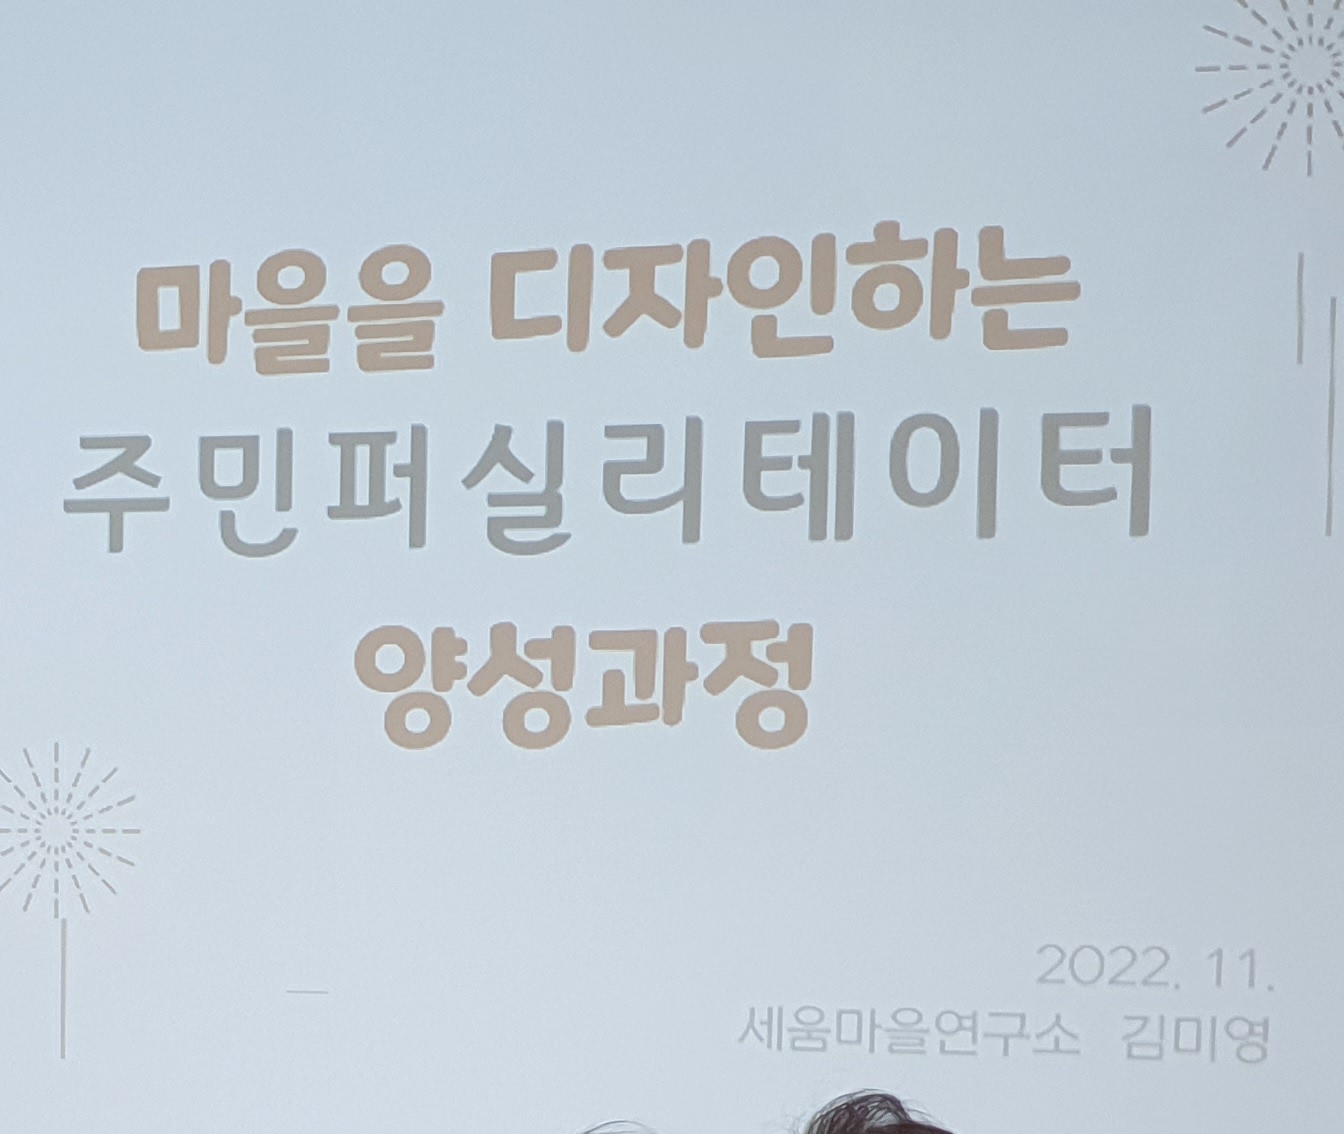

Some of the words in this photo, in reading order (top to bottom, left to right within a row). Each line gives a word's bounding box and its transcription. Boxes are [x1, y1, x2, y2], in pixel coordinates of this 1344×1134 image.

[135, 243, 445, 377] 마을을
[489, 219, 1082, 359] 디자인하는
[62, 403, 1153, 558] 주민퍼실리테이터
[352, 618, 814, 751] 양성과정
[737, 1004, 1082, 1058] 세움마을연구소
[1121, 1012, 1272, 1064] 김미영
[1036, 944, 1181, 990] 2022.
[1207, 947, 1275, 992] 11.
